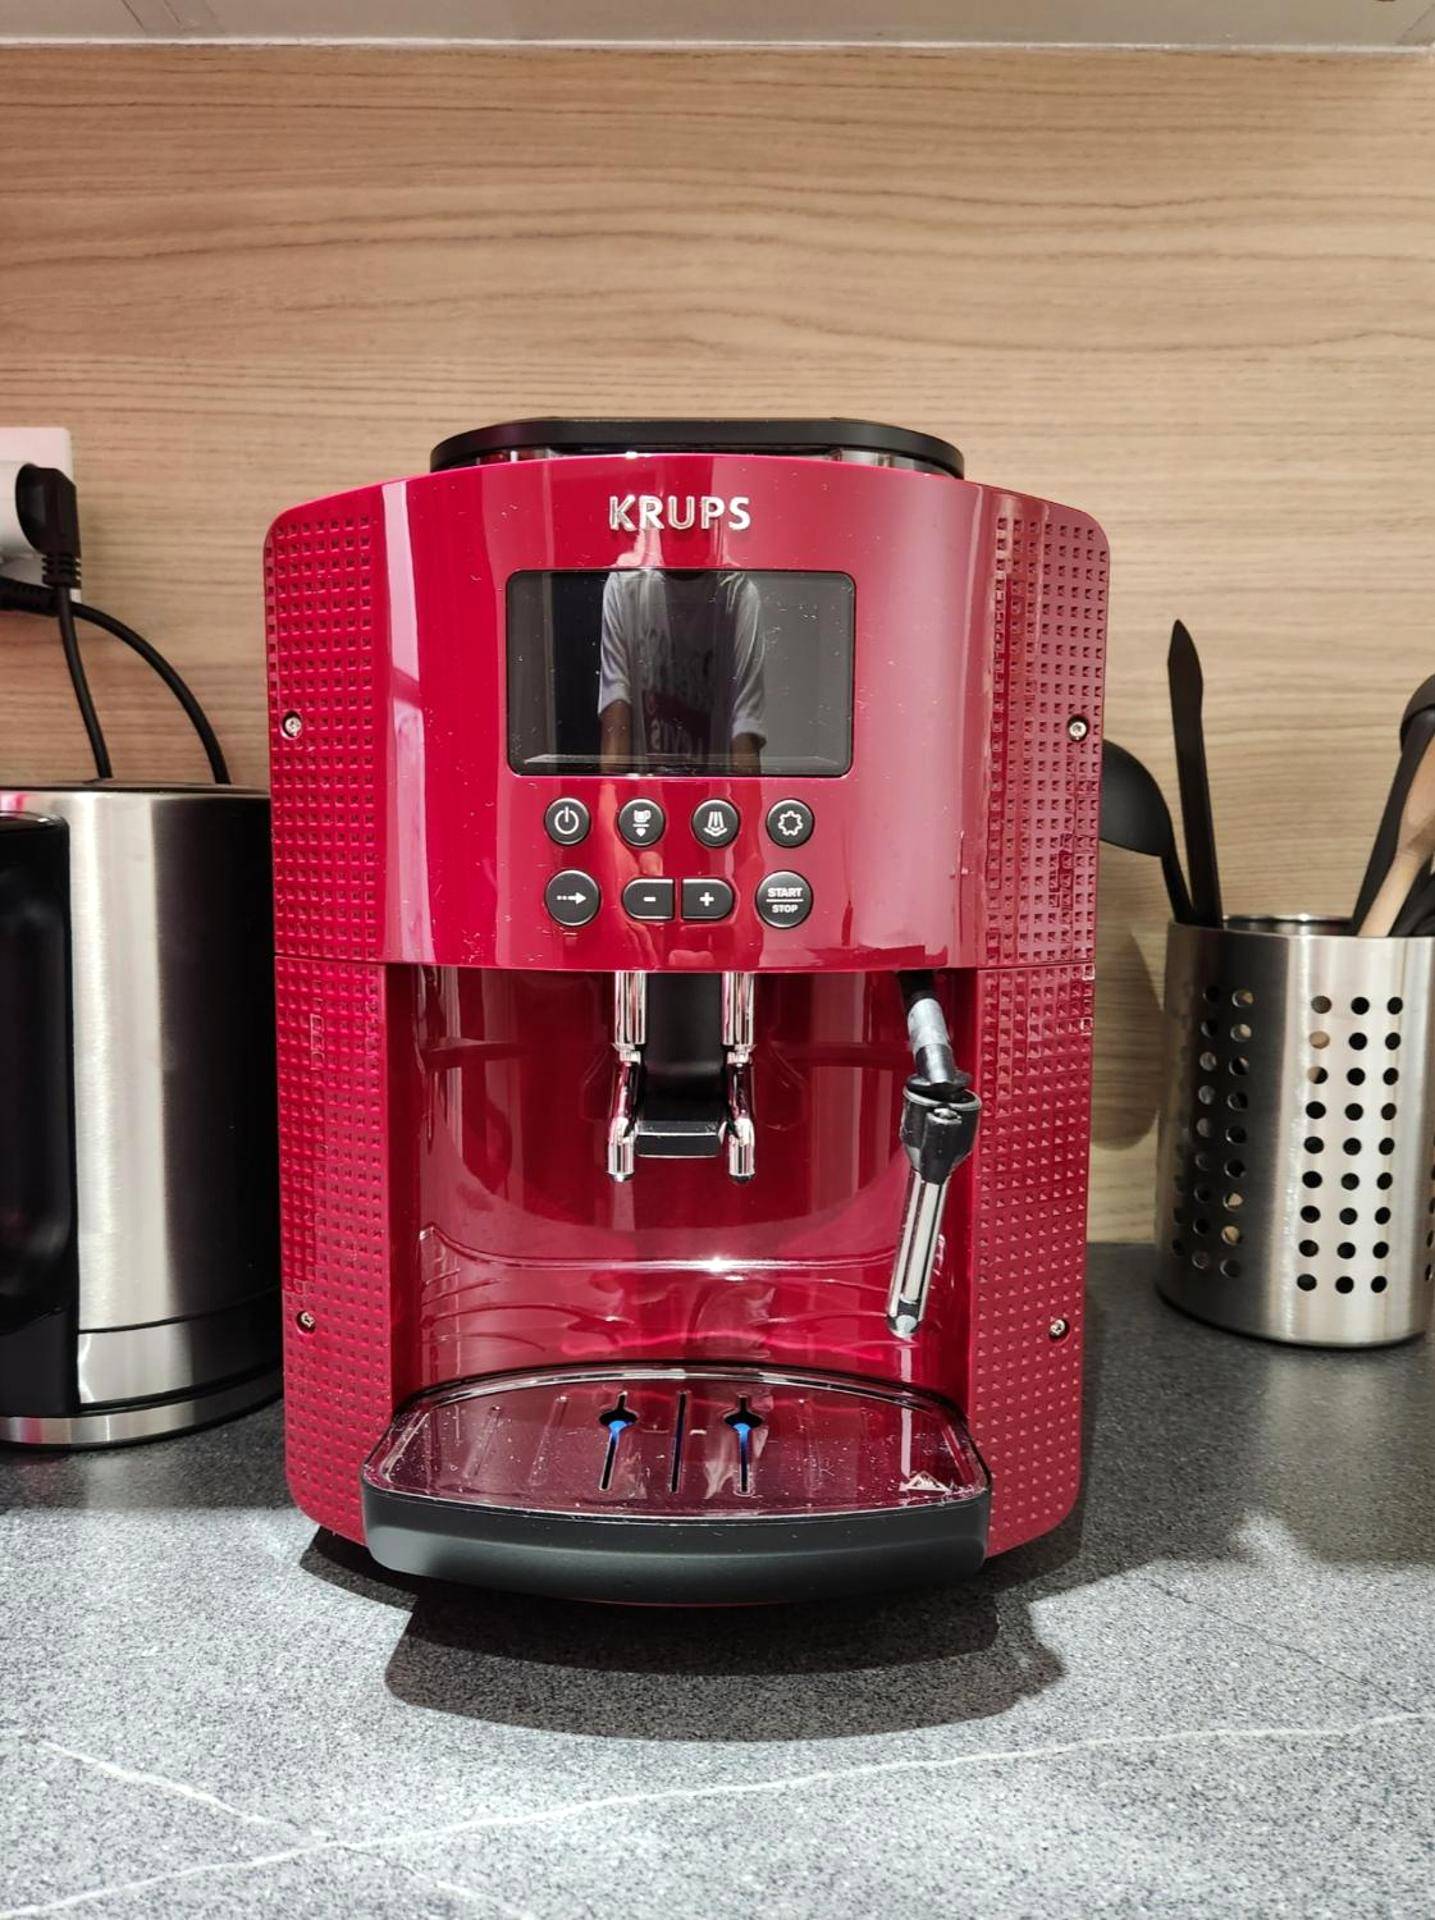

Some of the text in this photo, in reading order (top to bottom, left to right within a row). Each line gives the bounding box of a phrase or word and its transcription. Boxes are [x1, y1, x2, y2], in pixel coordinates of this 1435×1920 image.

[609, 494, 751, 531] KRUPS
[767, 887, 803, 898] START
[771, 904, 799, 913] STOP
